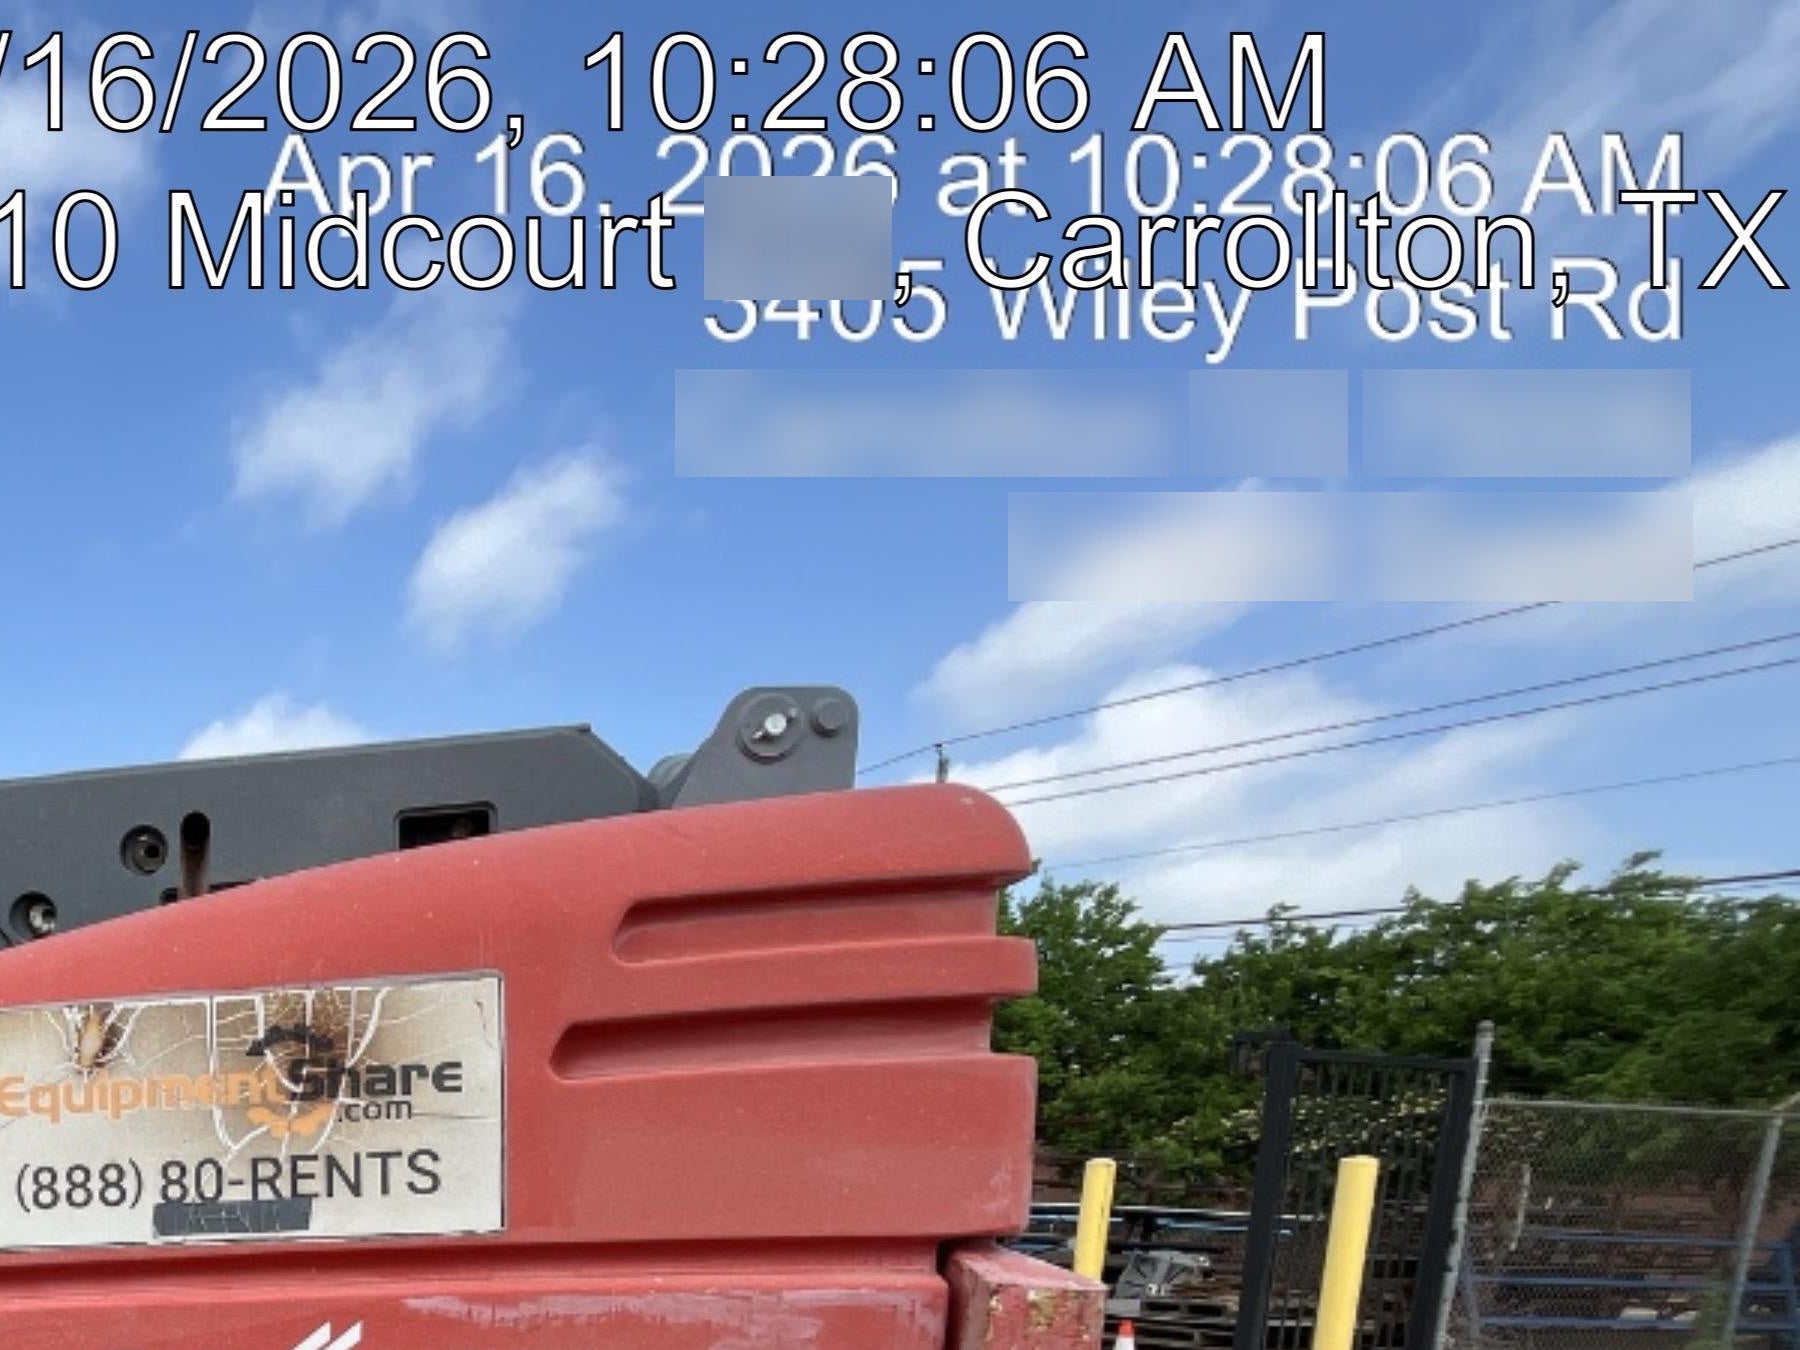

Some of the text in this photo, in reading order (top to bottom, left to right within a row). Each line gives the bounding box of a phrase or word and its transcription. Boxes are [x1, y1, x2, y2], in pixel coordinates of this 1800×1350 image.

[337, 1098, 413, 1123] .com
[16, 1147, 442, 1214] (888) 80-RENTS
